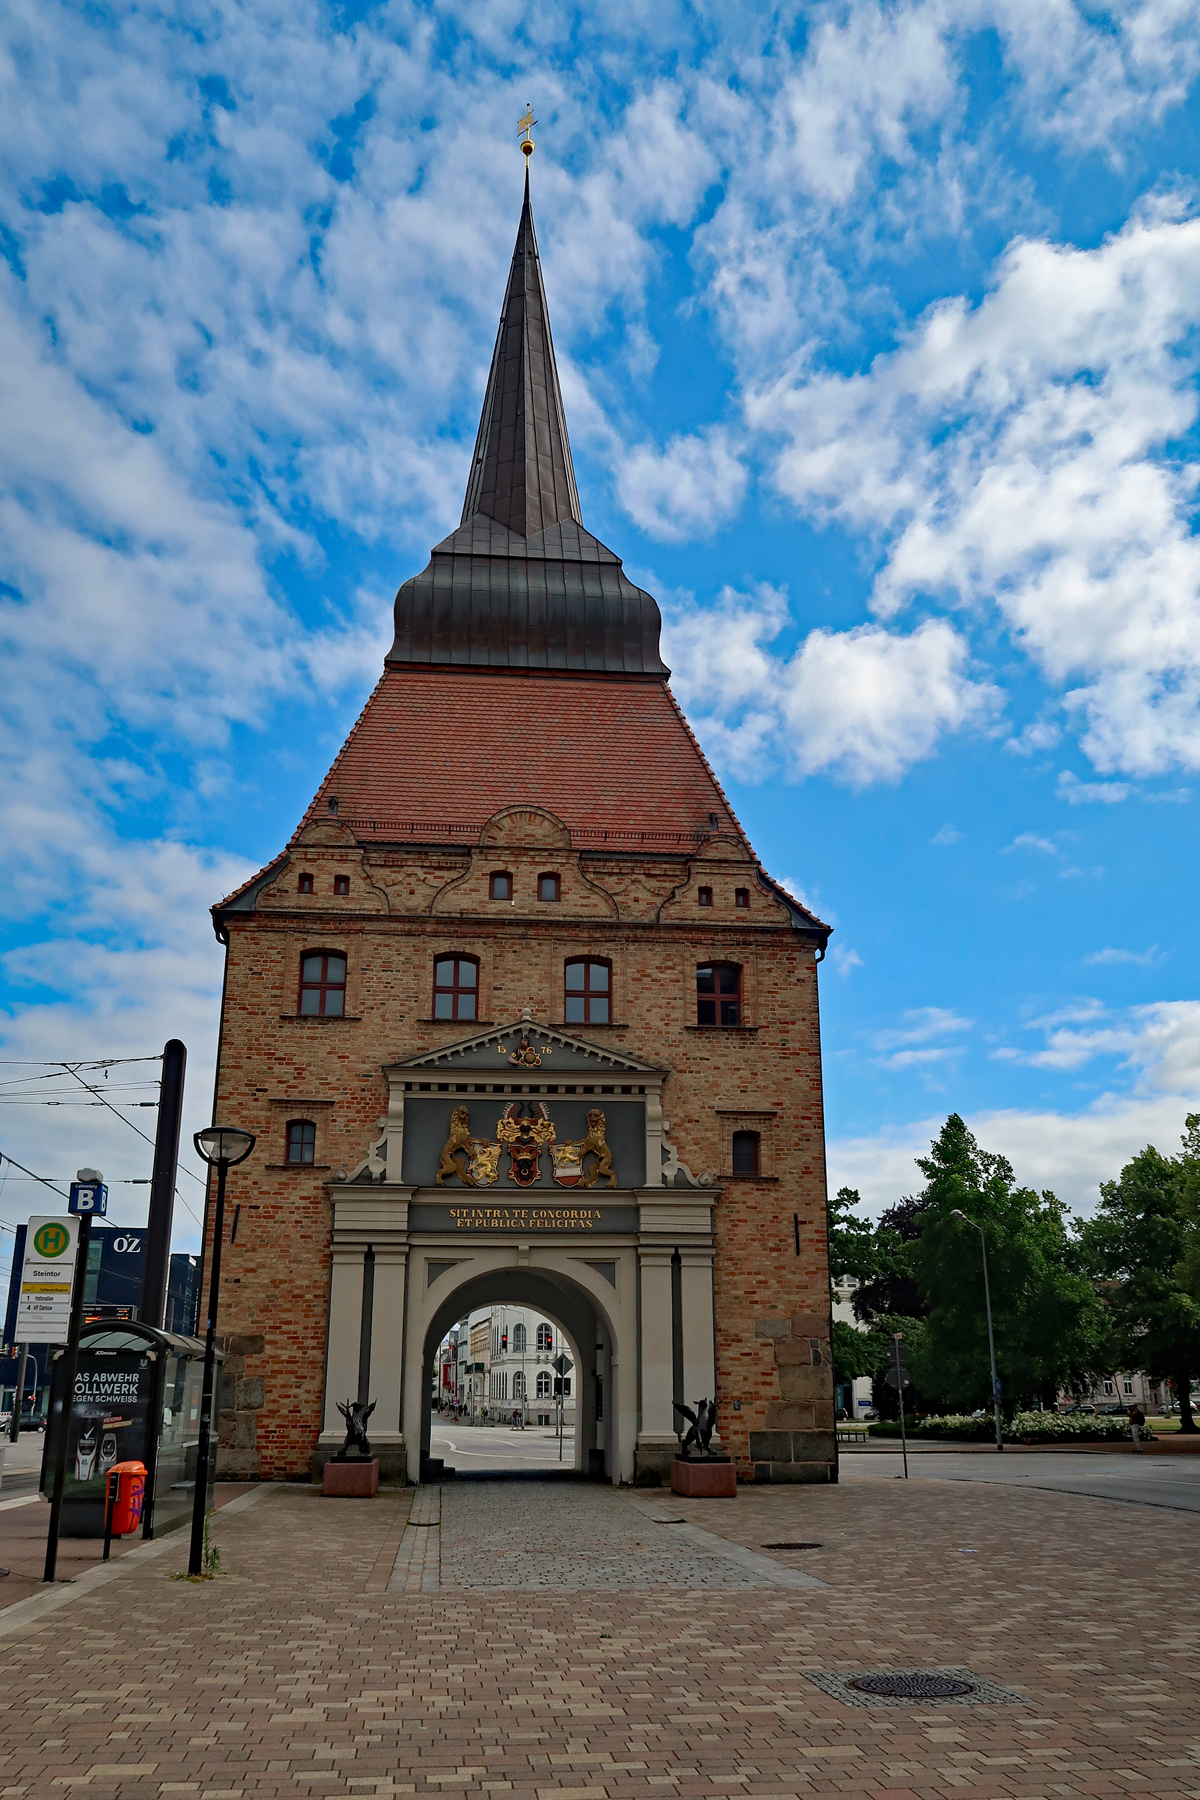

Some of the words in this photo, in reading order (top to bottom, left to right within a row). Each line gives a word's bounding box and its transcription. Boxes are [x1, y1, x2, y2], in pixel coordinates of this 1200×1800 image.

[497, 1046, 507, 1054] 15
[77, 1190, 95, 1210] B
[449, 1209, 469, 1218] SIT
[471, 1209, 509, 1218] INTRA
[513, 1209, 528, 1218] TE
[532, 1209, 601, 1219] CONCORDIA
[457, 1219, 472, 1228] ET
[475, 1219, 526, 1228] PUBLICA
[529, 1219, 593, 1228] FELICITAS
[43, 1231, 61, 1250] H
[74, 1373, 90, 1382] AS
[92, 1373, 140, 1382] ABWEHR
[74, 1383, 139, 1394] OLLWERK
[95, 1395, 138, 1403] SCHWEISS
